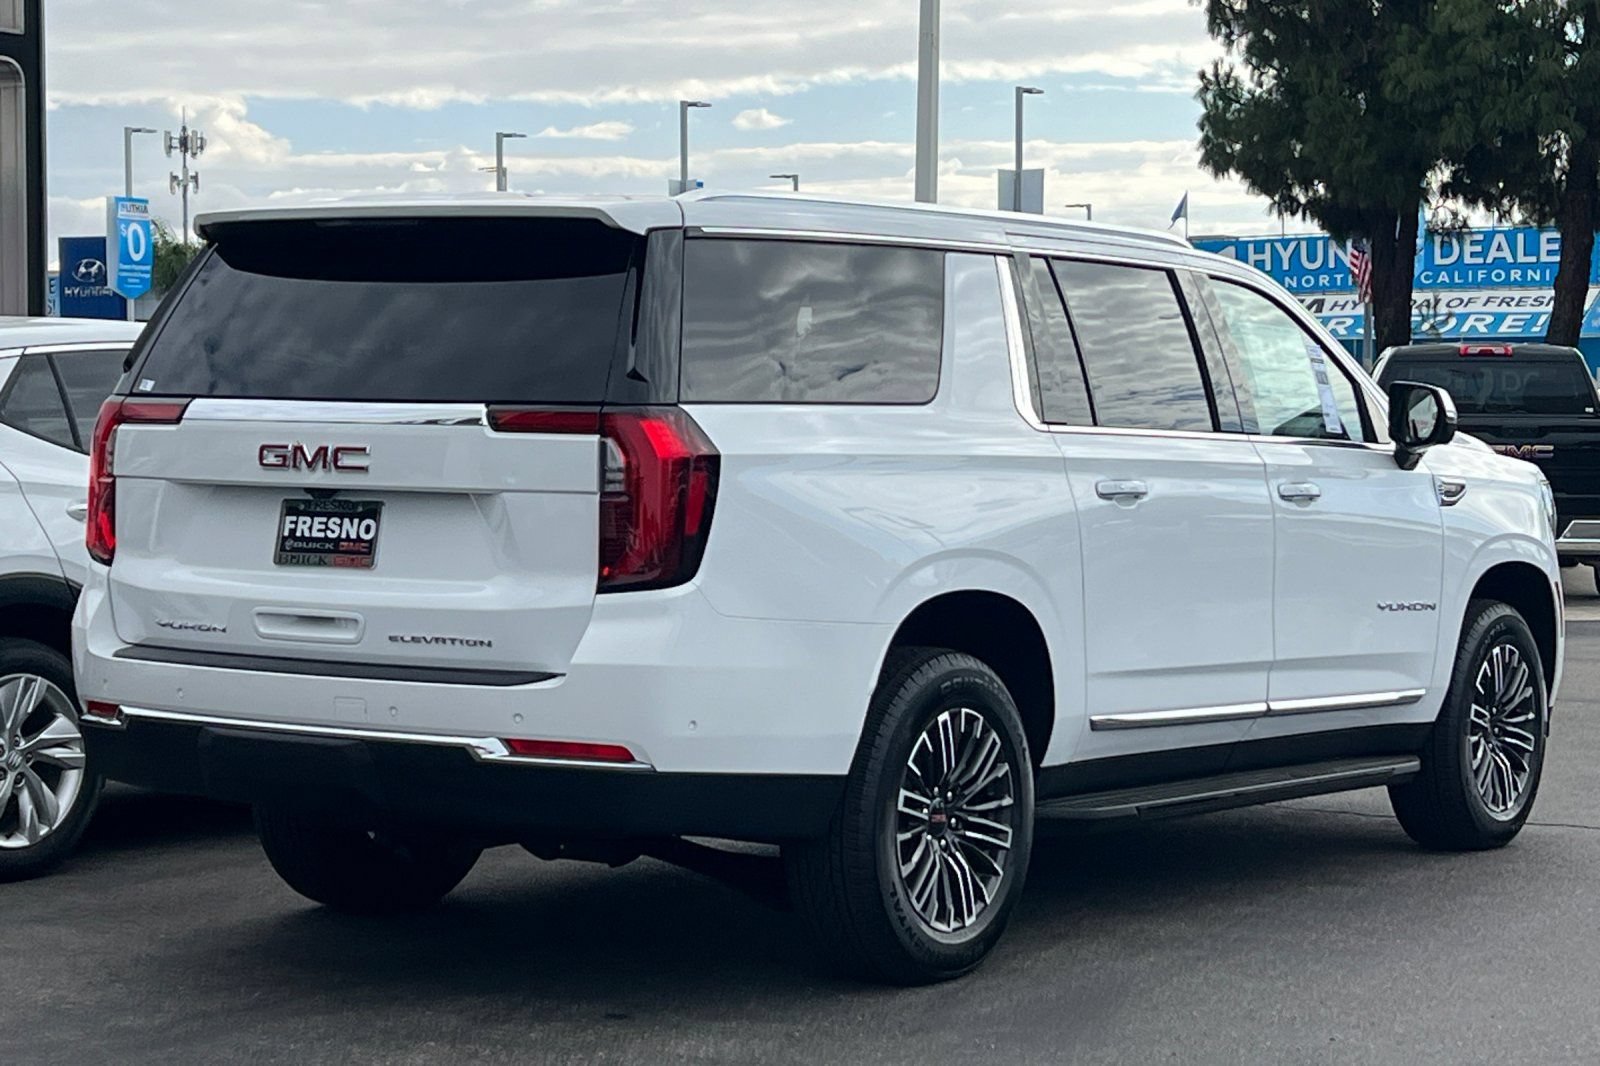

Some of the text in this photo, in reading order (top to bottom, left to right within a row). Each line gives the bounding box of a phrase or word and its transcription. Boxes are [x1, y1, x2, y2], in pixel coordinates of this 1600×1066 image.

[1248, 239, 1353, 271] HYUN
[1433, 231, 1561, 266] DEALE
[1420, 269, 1550, 284] CALIFORNI
[1446, 296, 1481, 309] OF
[258, 443, 371, 472] GMC
[283, 516, 377, 540] FRESNO
[293, 541, 334, 550] BUICK
[1377, 602, 1436, 611] YUKON
[154, 620, 227, 633] YUKON
[388, 635, 493, 648] ELEVATION
